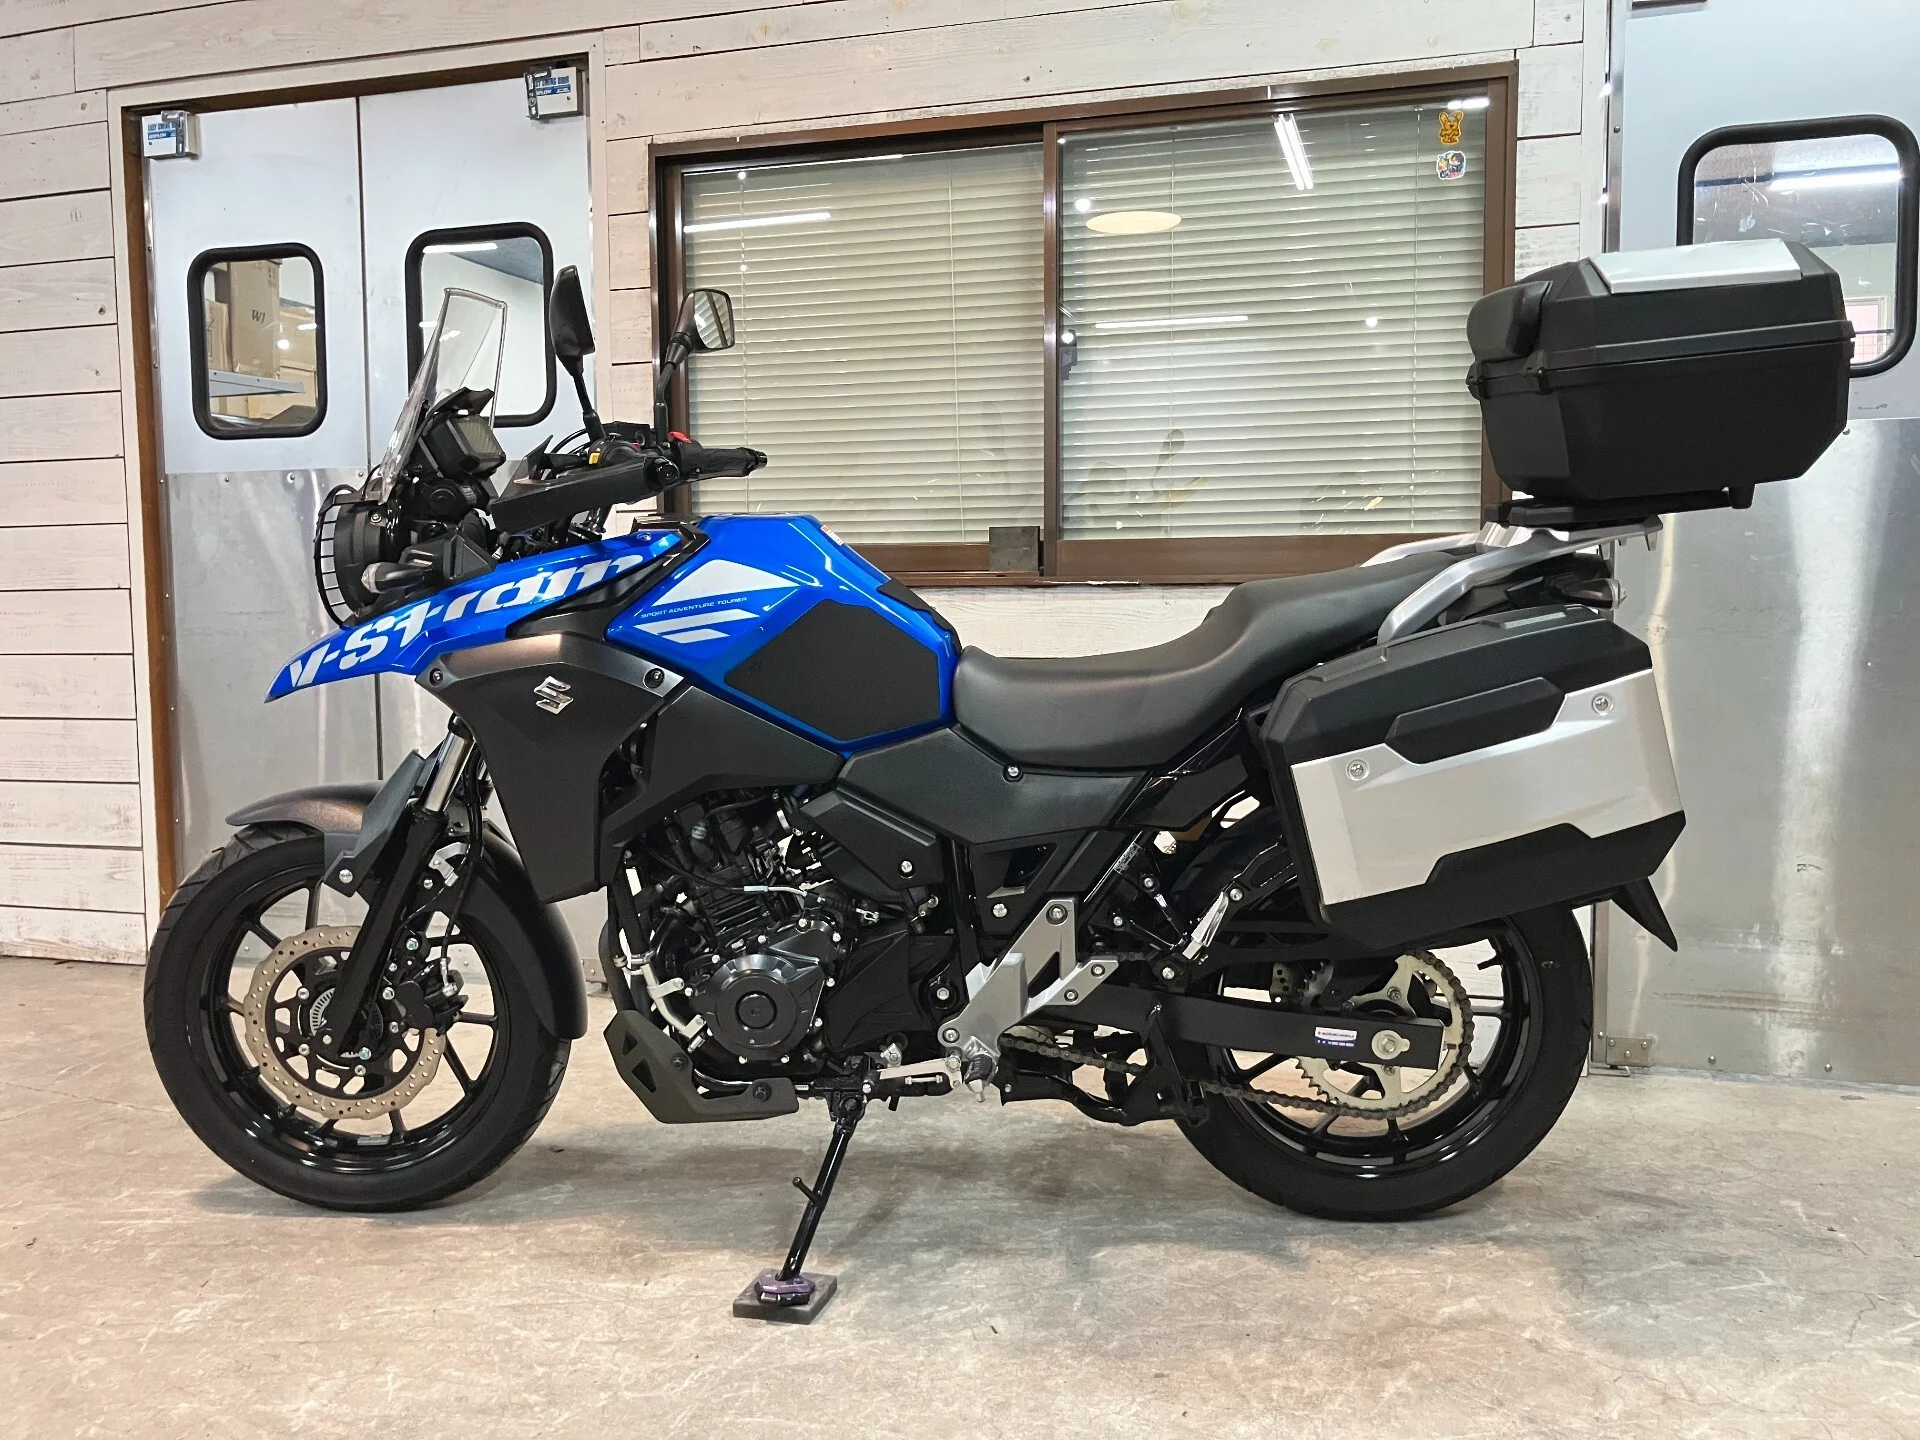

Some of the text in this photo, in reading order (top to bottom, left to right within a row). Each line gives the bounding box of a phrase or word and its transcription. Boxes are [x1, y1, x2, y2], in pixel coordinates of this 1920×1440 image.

[289, 554, 644, 687] V-Strom
[641, 596, 748, 619] SPORT ADVENTURE TOURER
